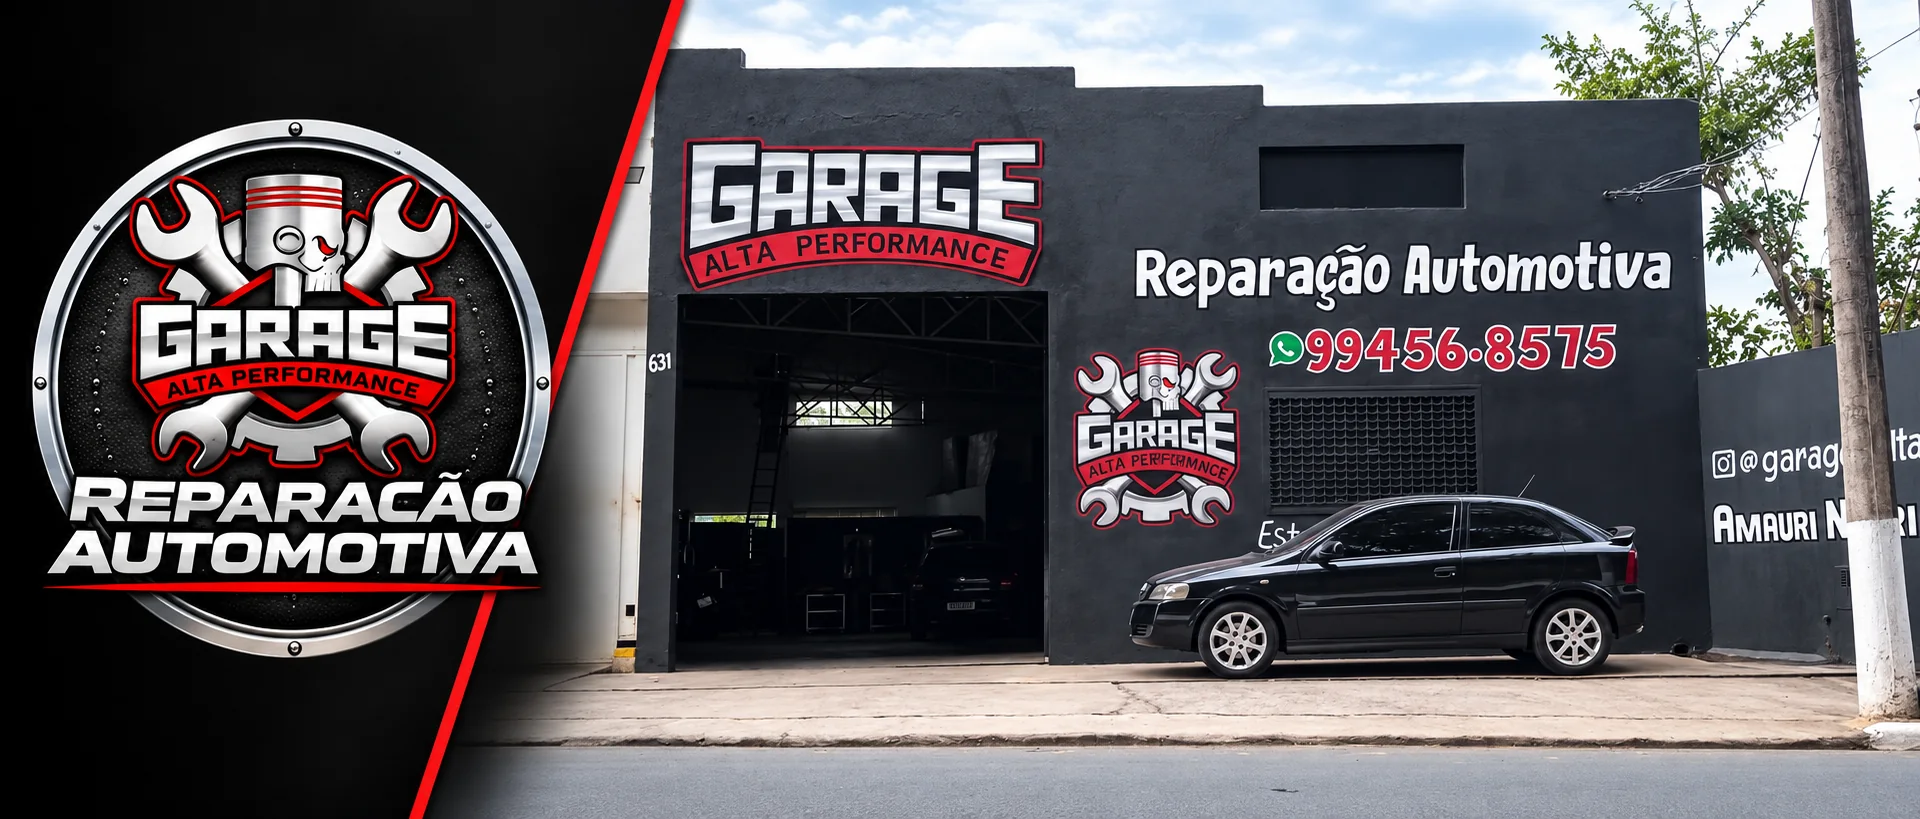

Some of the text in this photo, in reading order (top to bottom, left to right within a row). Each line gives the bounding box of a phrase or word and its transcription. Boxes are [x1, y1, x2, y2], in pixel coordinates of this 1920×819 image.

[690, 144, 1036, 249] GARAGE
[705, 232, 1009, 277] ALTA PERFORMANCE
[1135, 241, 1672, 312] Reparação Automotiva
[648, 352, 672, 374] 631
[1078, 412, 1235, 464] GARAGE
[1089, 457, 1125, 478] ALTA
